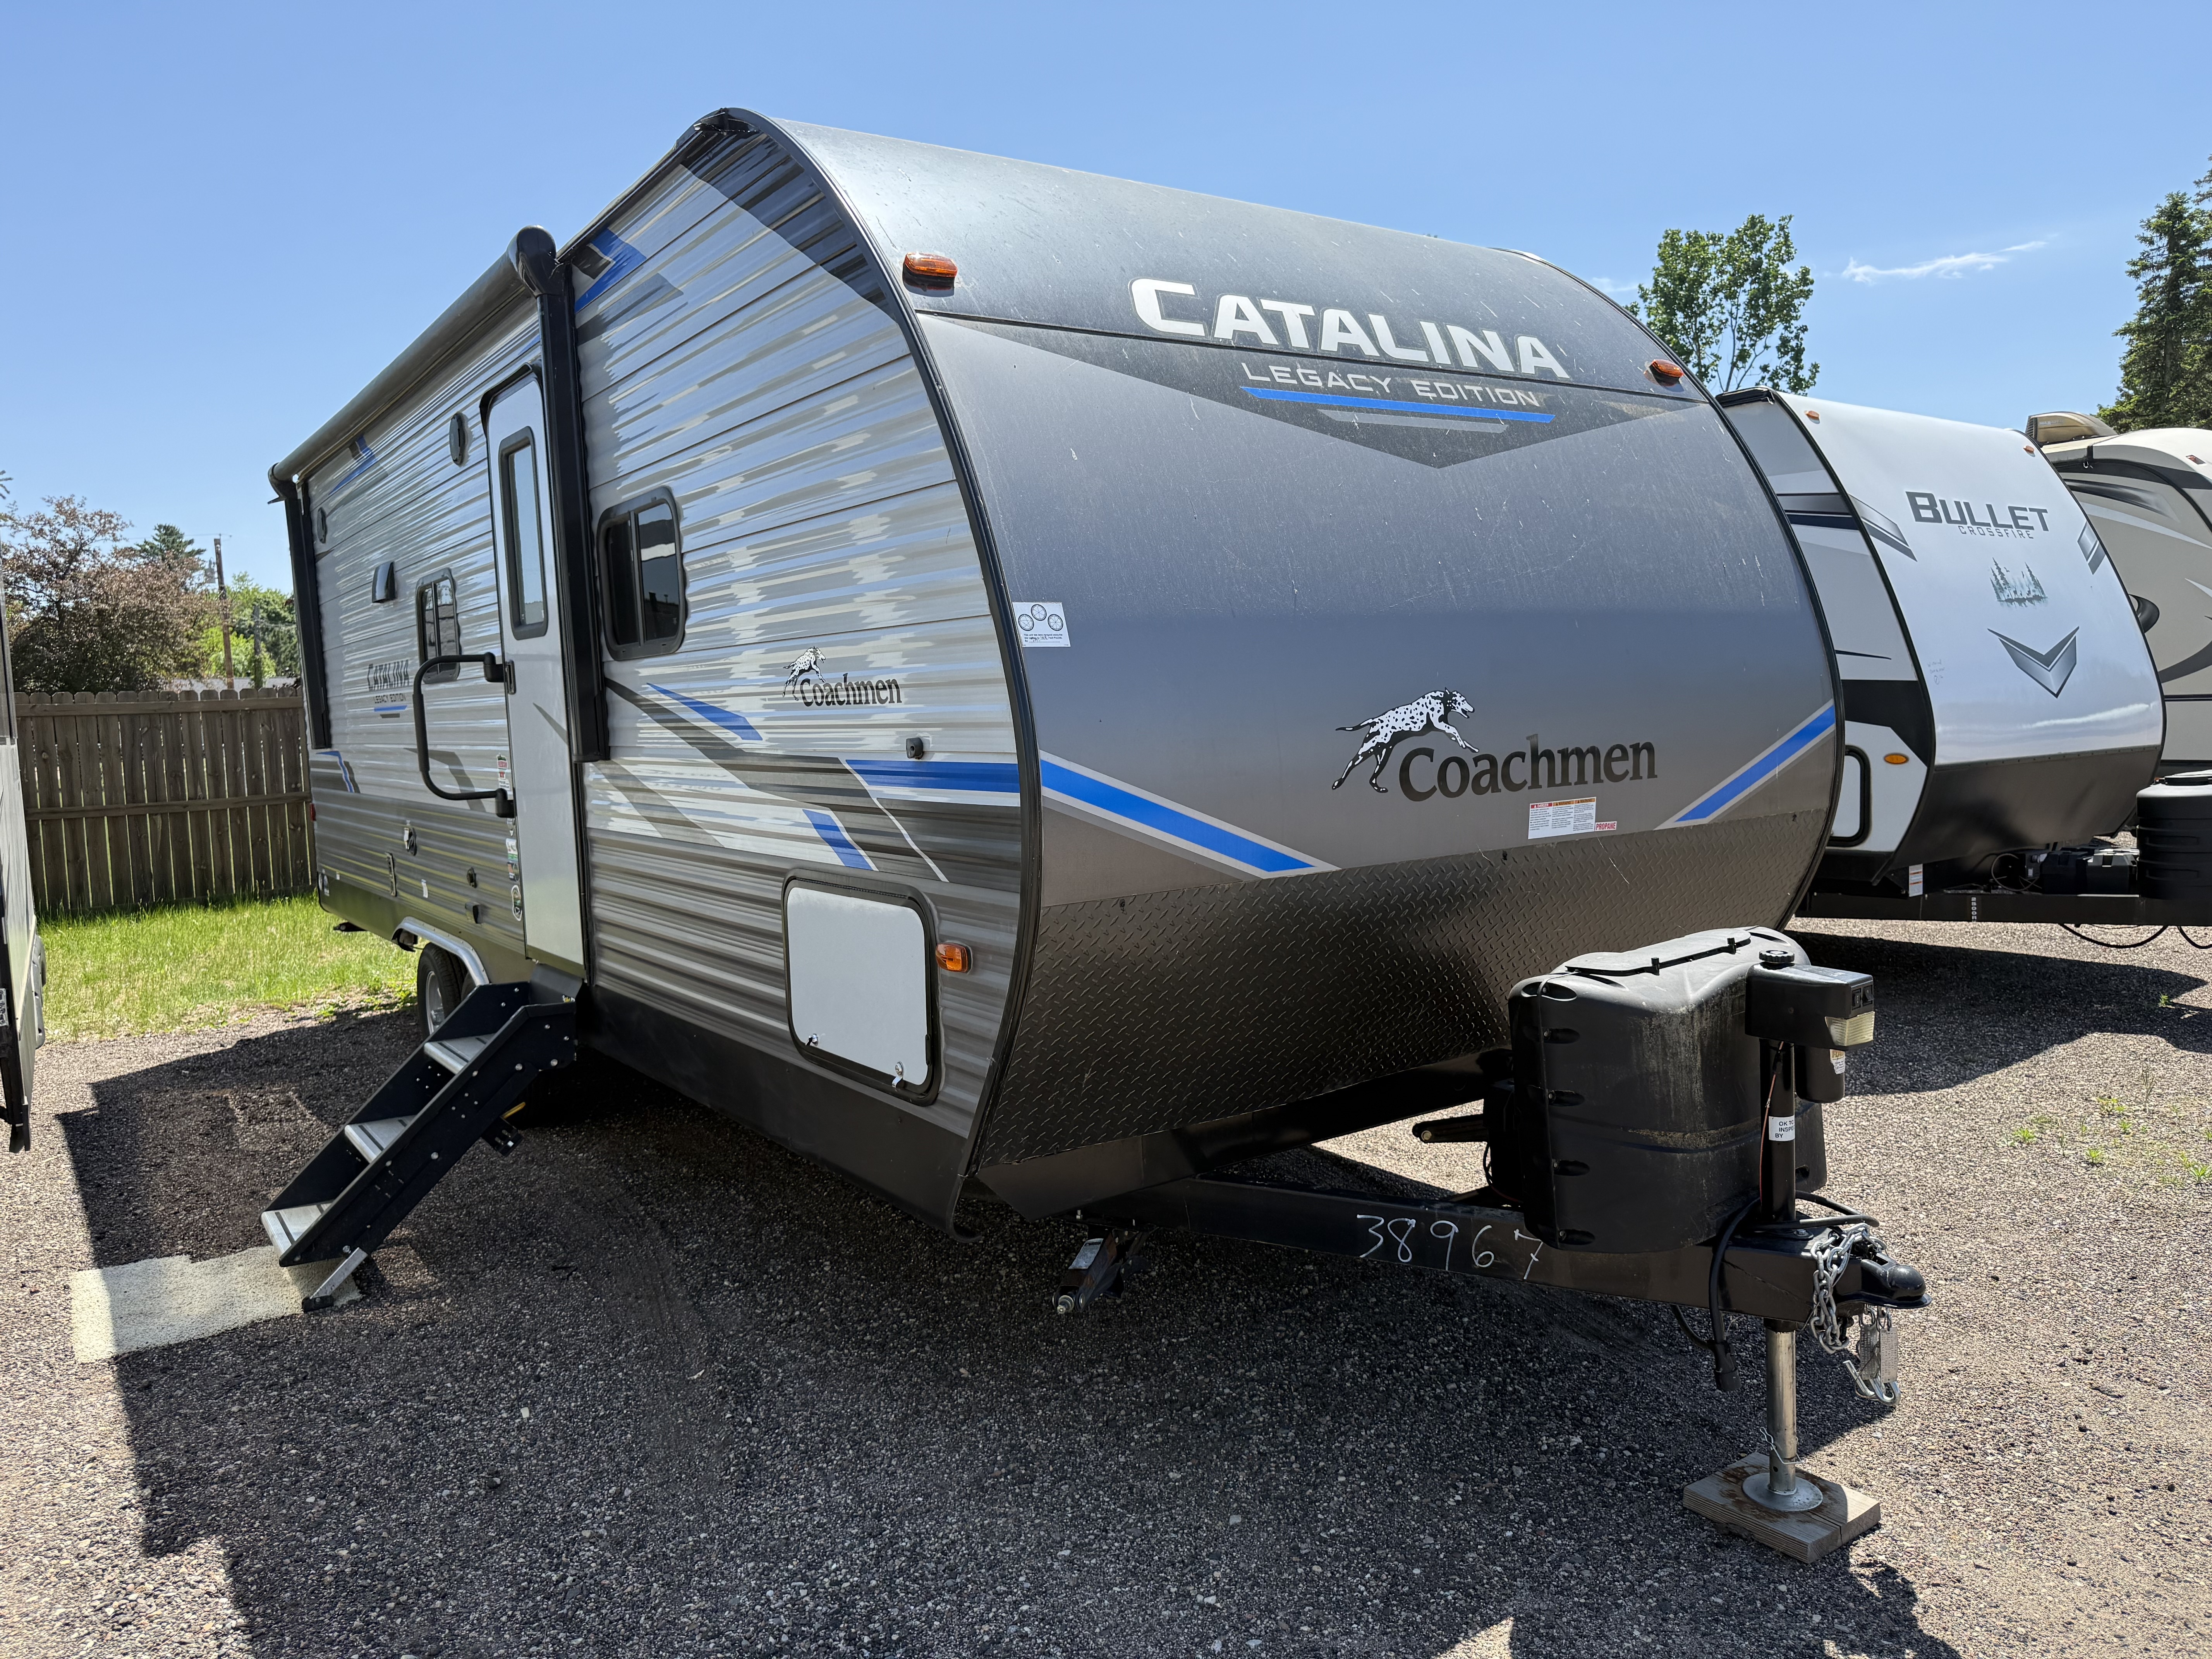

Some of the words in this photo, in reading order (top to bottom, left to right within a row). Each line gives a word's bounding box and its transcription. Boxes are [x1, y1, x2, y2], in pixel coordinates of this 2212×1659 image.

[1129, 277, 1570, 379] CATALINA
[1240, 362, 1392, 393] LEGACY
[1410, 379, 1541, 407] EDITION
[1905, 491, 2049, 532] BULLET
[1958, 525, 2034, 539] CROSSFIRE
[799, 672, 903, 707] Coachmen
[1398, 733, 1659, 802] Coachmen
[1596, 822, 1616, 830] PROPANE
[1356, 1213, 1544, 1280] 38967
